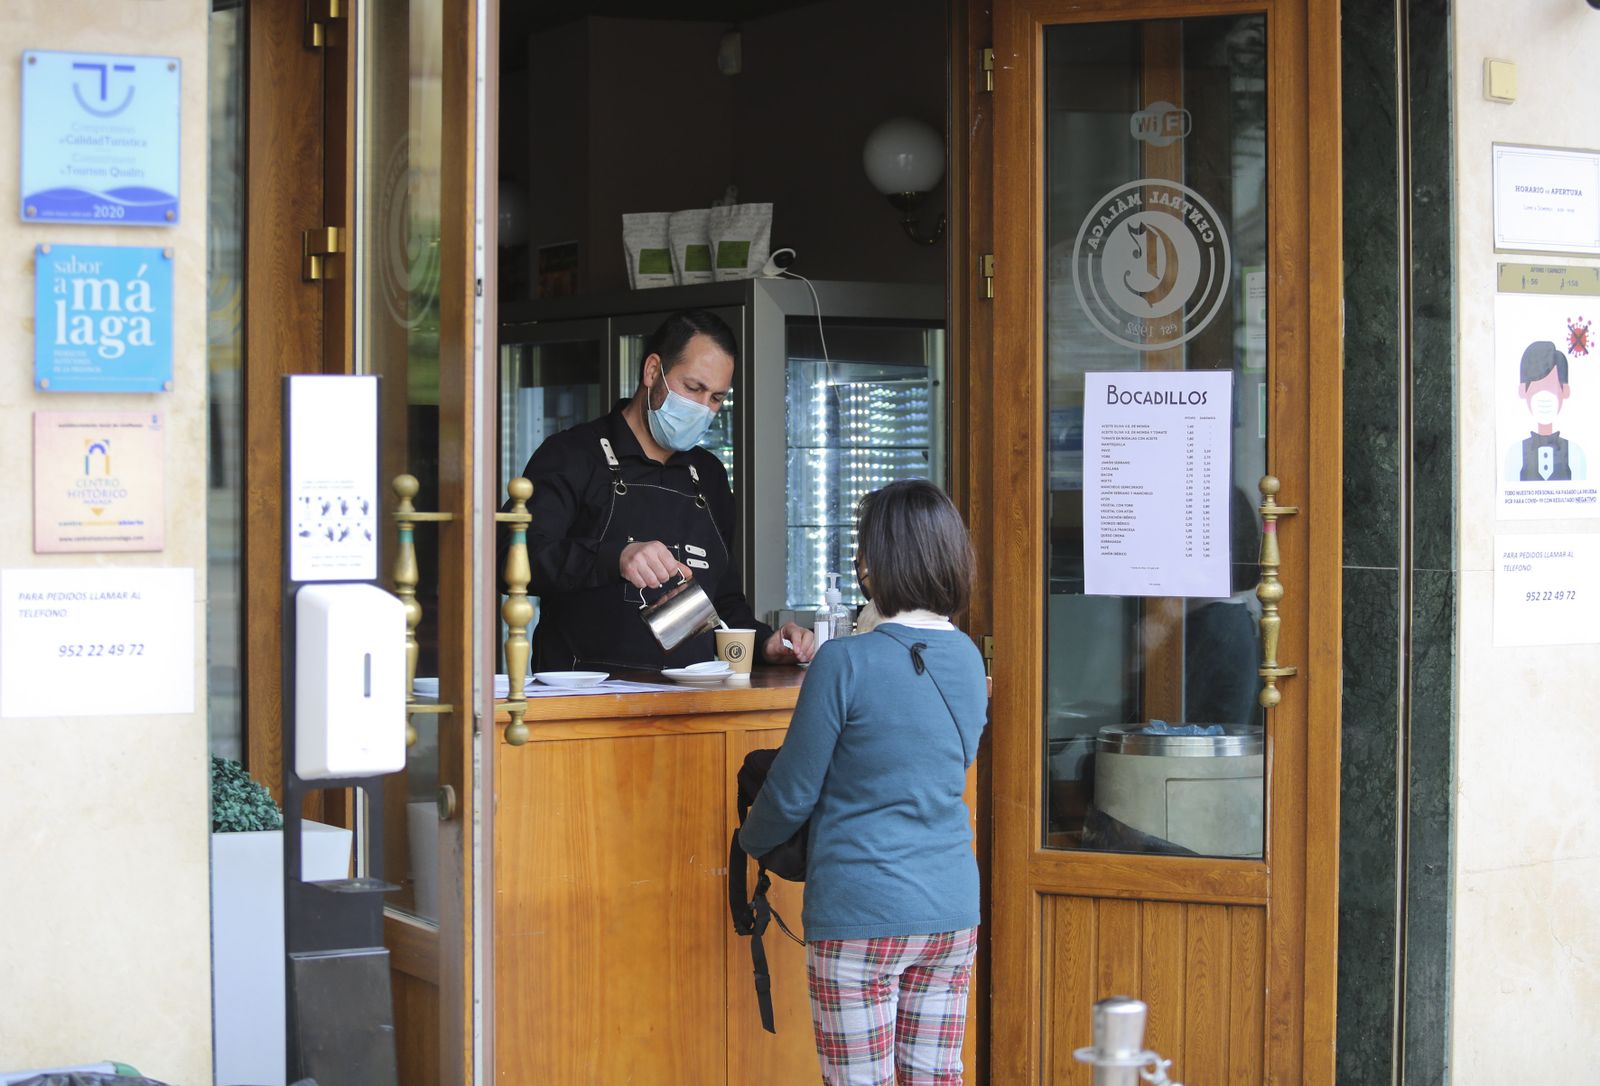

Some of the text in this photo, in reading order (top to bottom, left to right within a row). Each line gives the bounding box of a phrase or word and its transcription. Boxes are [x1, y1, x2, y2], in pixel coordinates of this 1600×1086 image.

[1515, 185, 1544, 194] HORARIO
[1551, 188, 1583, 196] APERTURA
[93, 205, 125, 218] 2020
[53, 255, 102, 274] sabor
[53, 276, 67, 294] a
[54, 299, 155, 359] laga
[76, 478, 120, 489] CENTRO
[67, 487, 128, 498] HISTÓRICO
[1519, 551, 1542, 559] PEDIDOS
[18, 592, 141, 600] PARA PEDIDOS LLAMAR AL
[1526, 590, 1576, 602] 952 22 49 72
[58, 643, 145, 657] 952 22 49 72
